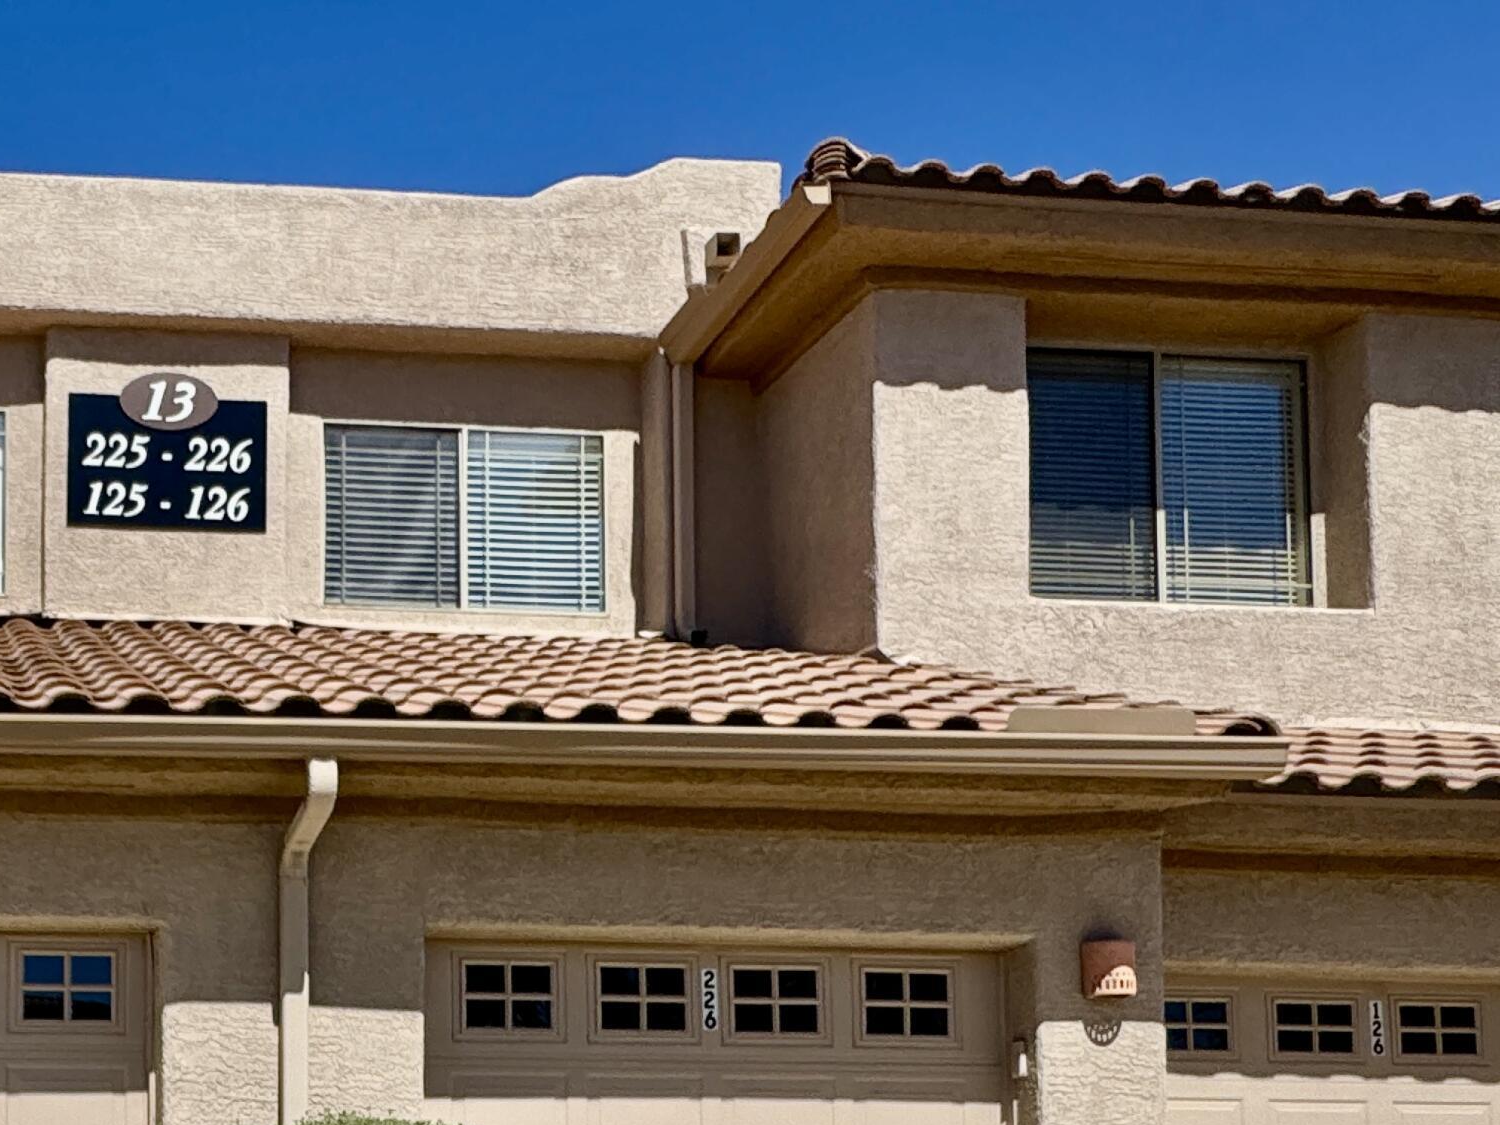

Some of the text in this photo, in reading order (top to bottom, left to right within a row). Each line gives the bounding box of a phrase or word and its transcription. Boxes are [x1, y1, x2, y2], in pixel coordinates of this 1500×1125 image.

[141, 379, 197, 423] 13
[81, 432, 254, 474] 225 - 226
[82, 480, 251, 523] 125 - 126
[703, 970, 717, 1030] 226
[1371, 1002, 1384, 1055] 126
